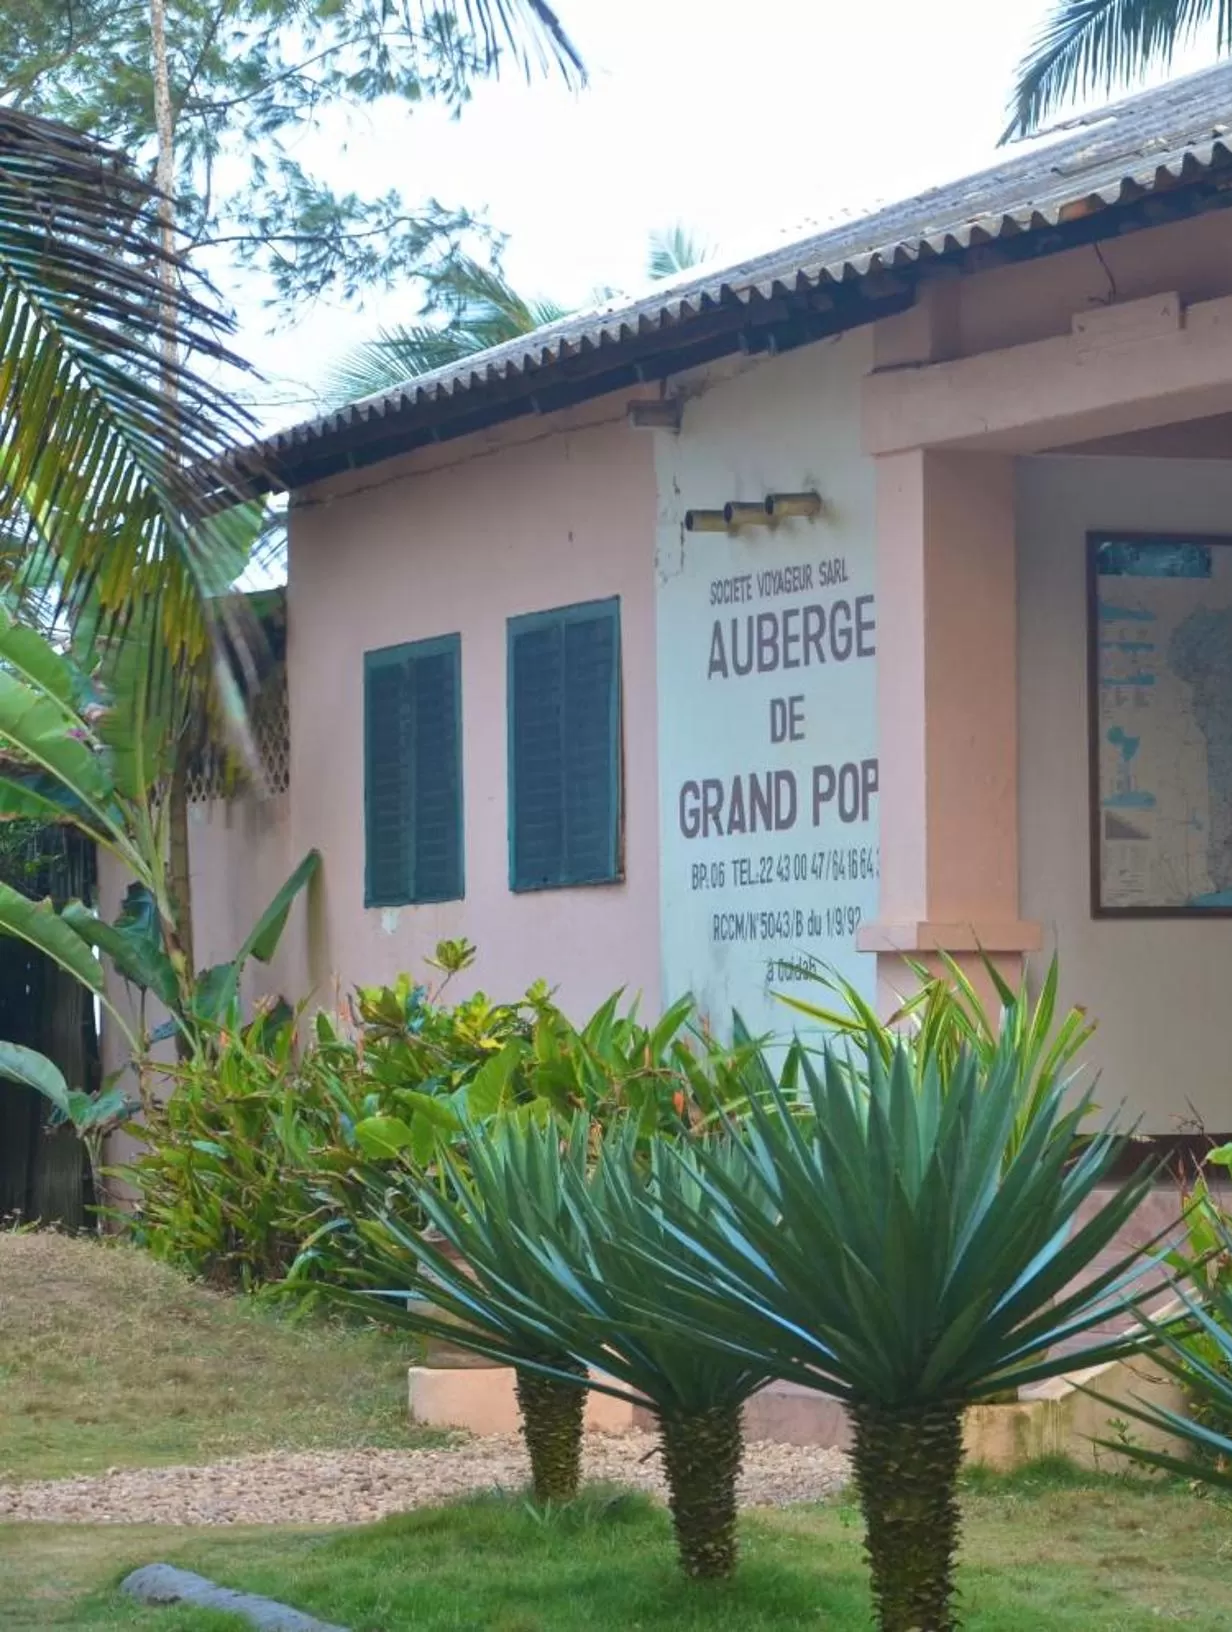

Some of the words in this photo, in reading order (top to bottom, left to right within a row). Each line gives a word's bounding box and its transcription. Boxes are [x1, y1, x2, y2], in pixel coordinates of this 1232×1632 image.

[757, 564, 814, 598] VOYAGEUR
[819, 558, 848, 587] SARL
[708, 594, 876, 680] AUBERGE
[769, 694, 805, 743] DE
[680, 770, 797, 839] GRAND
[807, 908, 822, 936] du
